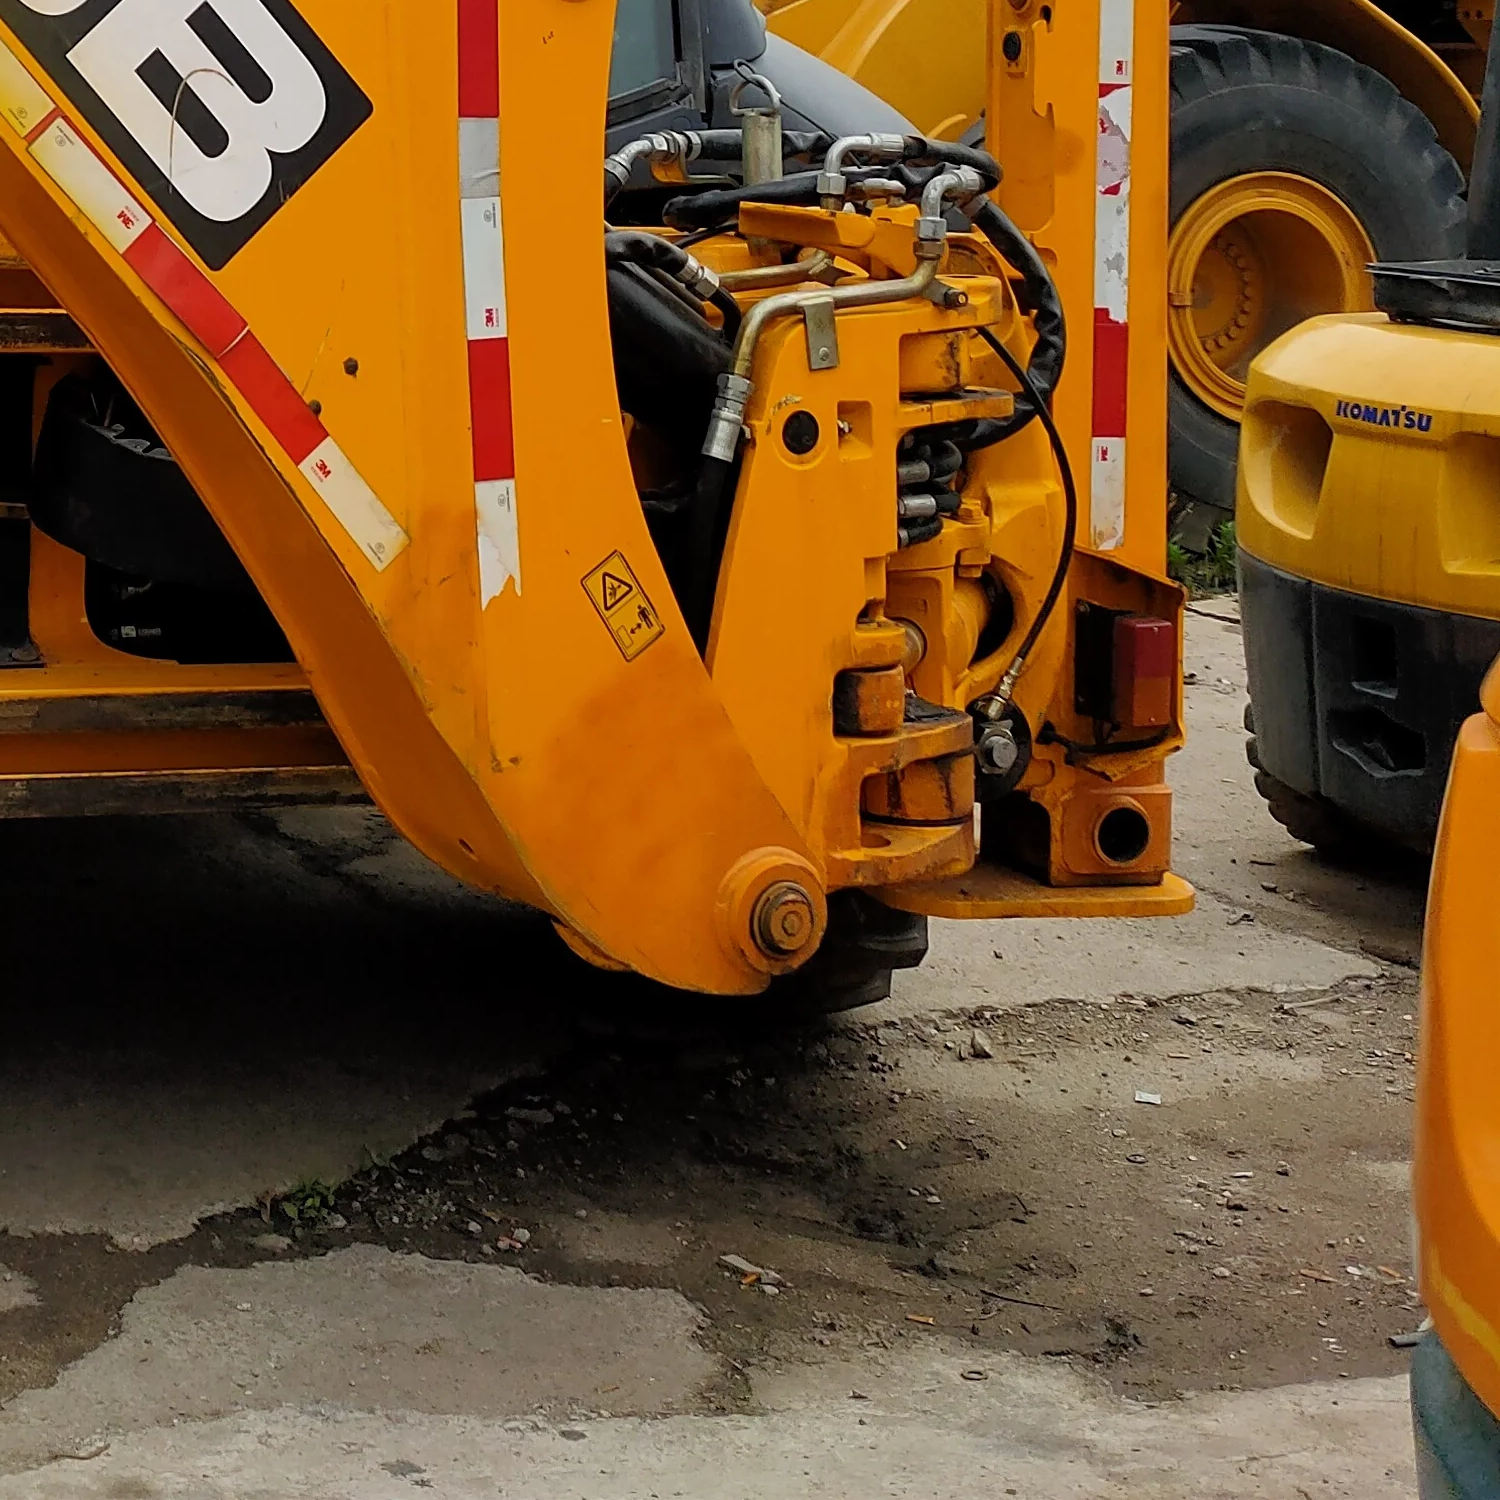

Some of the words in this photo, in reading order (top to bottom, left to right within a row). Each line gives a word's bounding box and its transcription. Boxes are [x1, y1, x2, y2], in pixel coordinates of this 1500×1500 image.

[1116, 60, 1123, 75] 3M
[117, 210, 135, 229] 3M
[485, 308, 494, 327] 3M
[1336, 399, 1433, 432] KOMATSU
[1101, 446, 1108, 461] 3M
[315, 459, 331, 478] 3M
